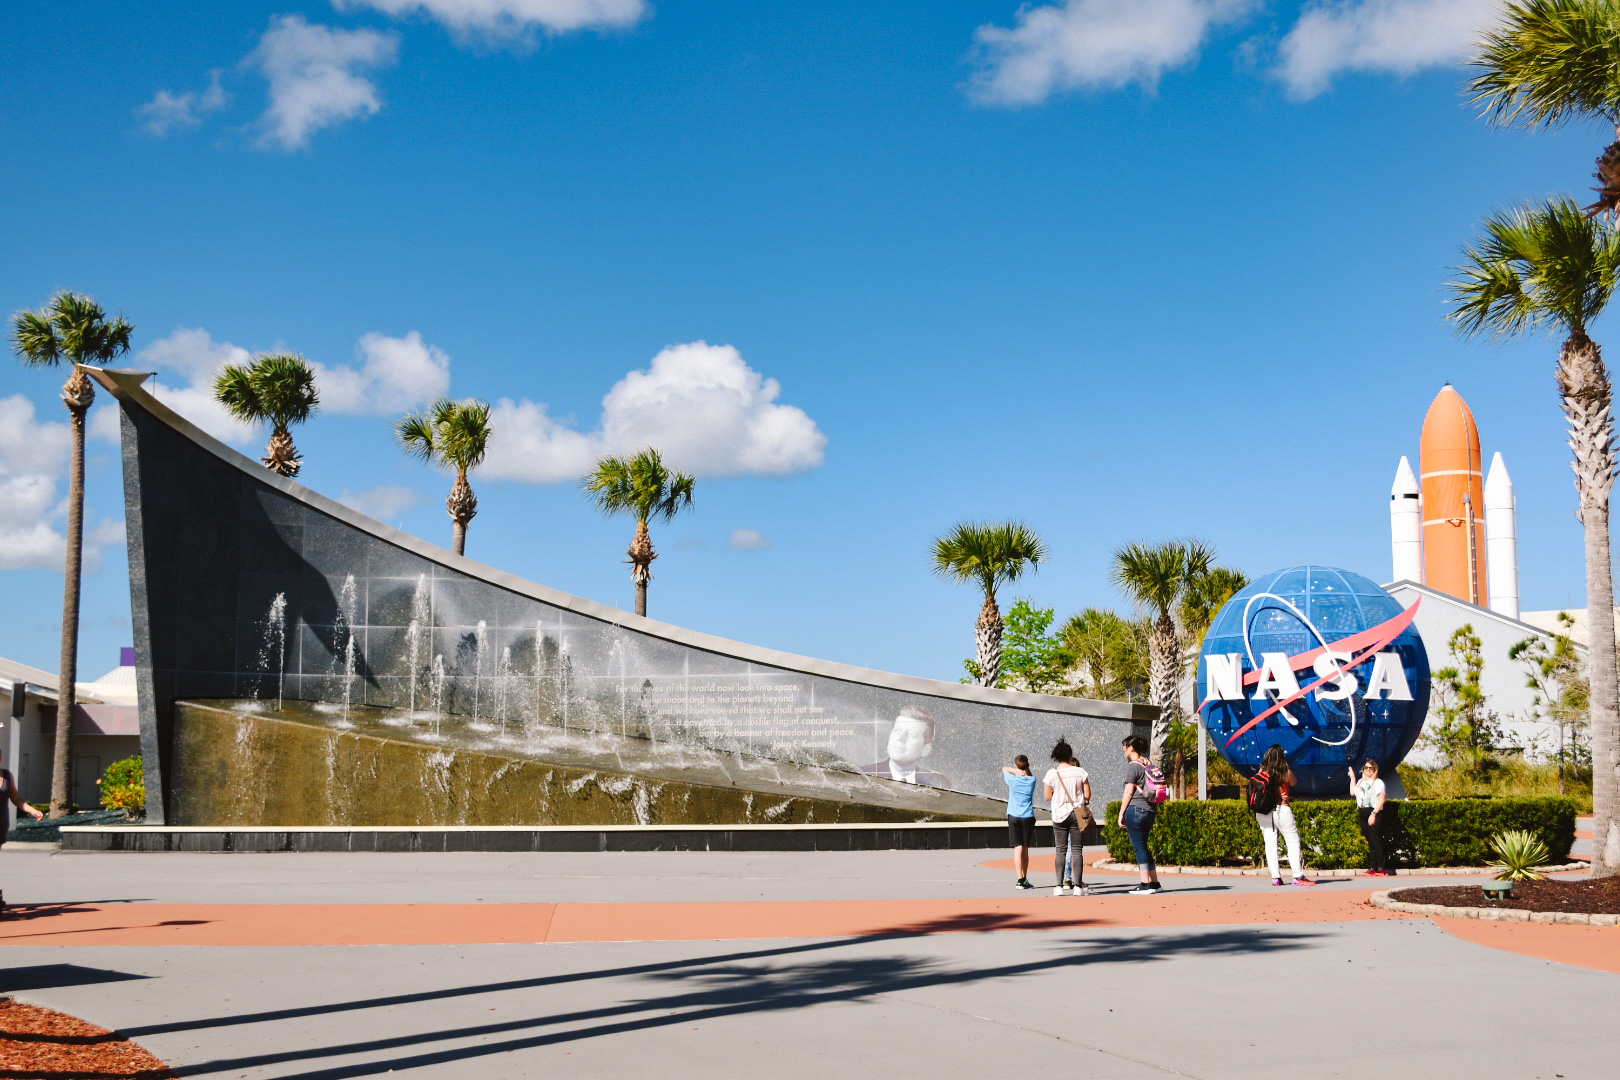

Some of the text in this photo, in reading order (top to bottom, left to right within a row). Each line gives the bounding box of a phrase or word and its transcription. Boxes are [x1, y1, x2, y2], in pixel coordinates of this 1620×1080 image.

[1204, 651, 1414, 702] NASA
[615, 684, 628, 693] For
[666, 684, 675, 693] of
[677, 683, 689, 693] the
[692, 683, 715, 692] world
[717, 684, 735, 692] now
[737, 683, 754, 692] look
[757, 683, 773, 692] into
[775, 684, 800, 694] space,
[690, 695, 704, 704] and
[707, 695, 716, 703] to
[718, 695, 730, 703] the
[732, 694, 761, 705] planets
[764, 694, 794, 705] beyond
[657, 706, 673, 715] and
[690, 705, 709, 715] have
[711, 705, 739, 715] vowed
[741, 705, 757, 714] that
[774, 704, 792, 714] shall
[795, 705, 808, 713] not
[676, 718, 682, 726] it
[725, 716, 734, 727] by
[745, 716, 771, 726] hostile
[773, 716, 789, 728] flag
[791, 716, 800, 725] of
[802, 716, 840, 727] conquest,
[715, 728, 725, 739] by
[734, 728, 763, 737] banner
[765, 728, 775, 737] of
[776, 727, 809, 737] freedom
[811, 727, 827, 736] and
[830, 729, 856, 739] peace.
[801, 739, 838, 750] Kennedy
